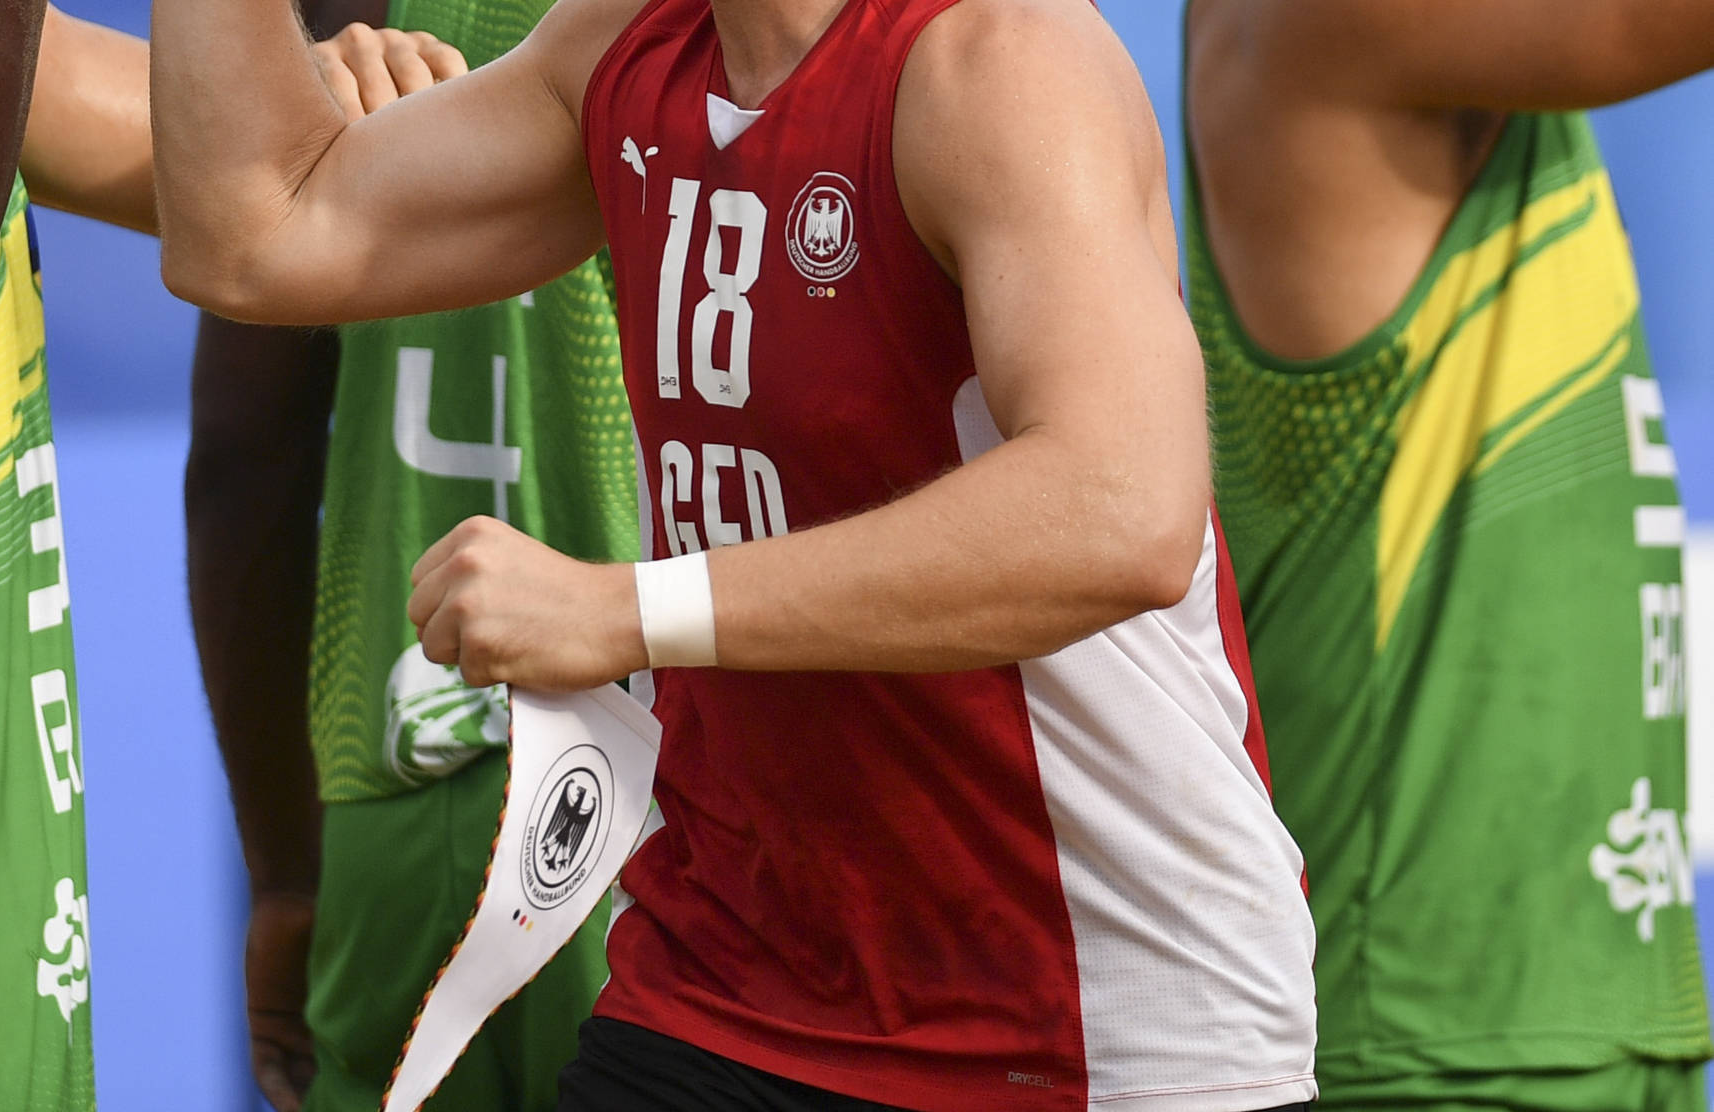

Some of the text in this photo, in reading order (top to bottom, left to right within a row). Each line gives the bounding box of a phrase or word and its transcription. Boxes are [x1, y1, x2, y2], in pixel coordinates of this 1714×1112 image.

[657, 177, 767, 408] 18
[393, 346, 522, 523] 4
[1007, 1071, 1054, 1088] DRYCELL
